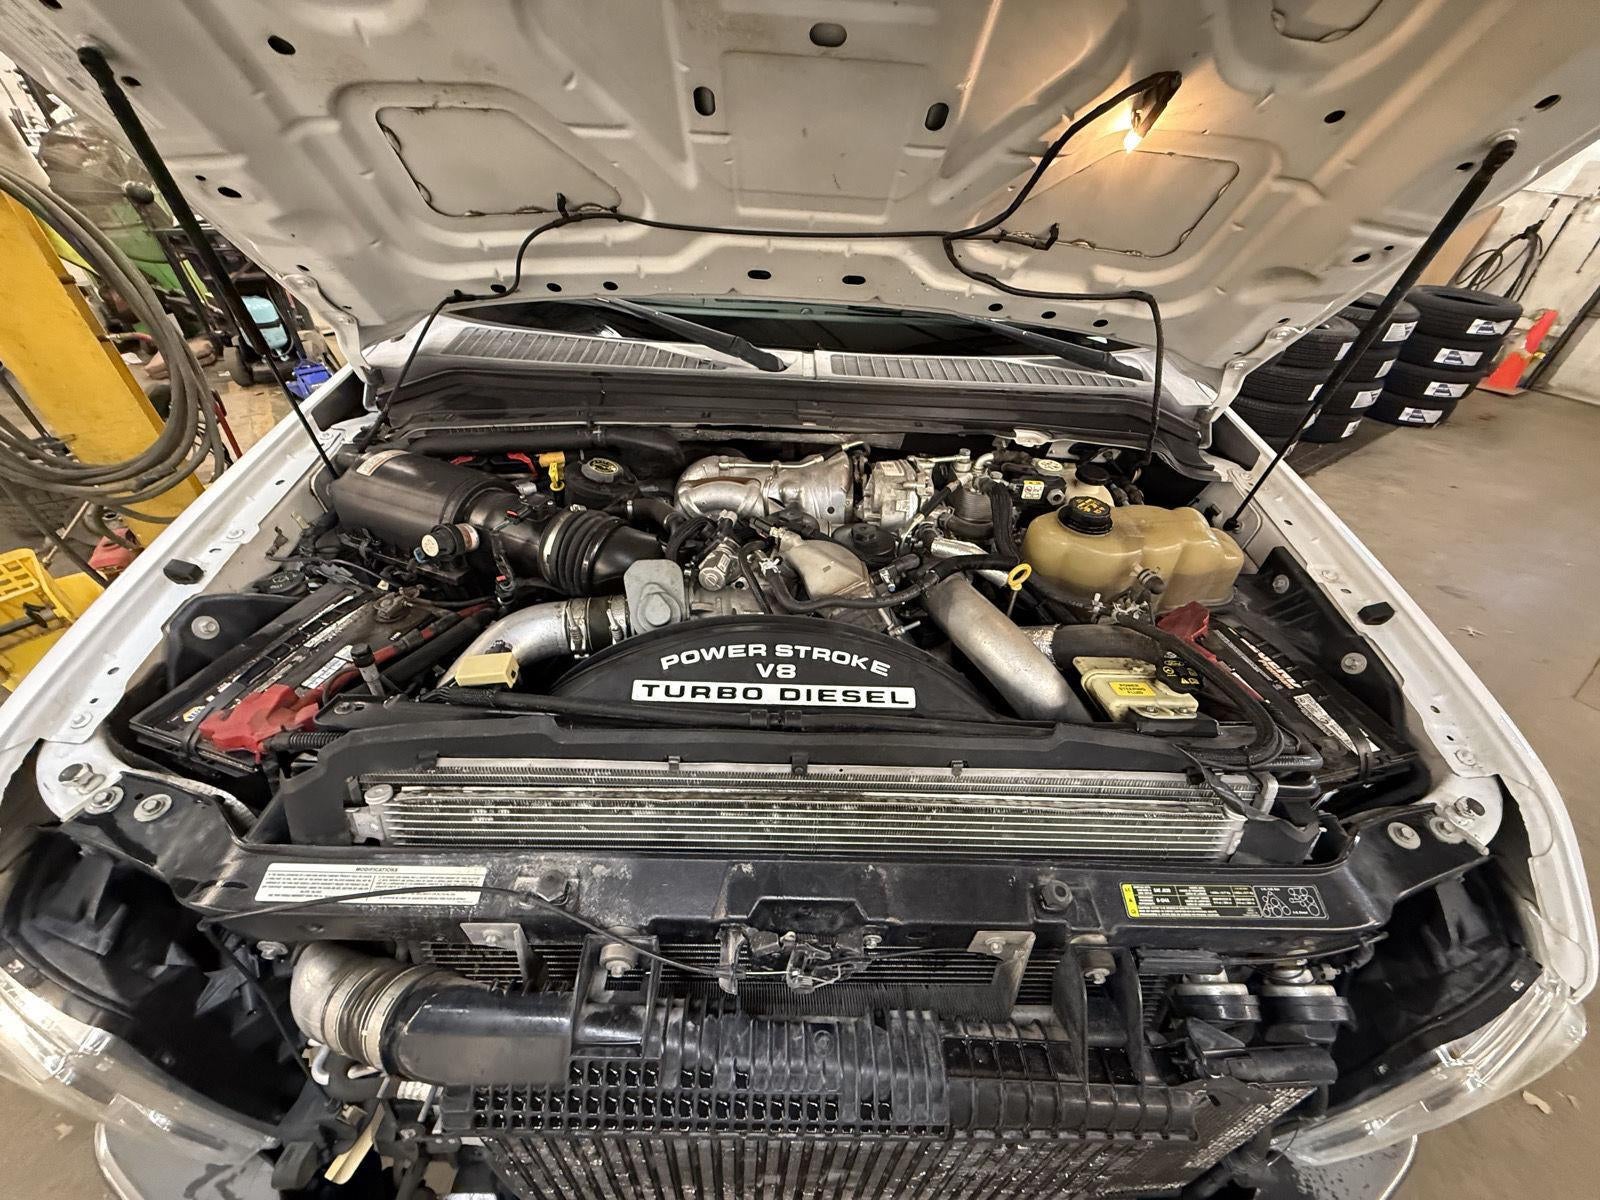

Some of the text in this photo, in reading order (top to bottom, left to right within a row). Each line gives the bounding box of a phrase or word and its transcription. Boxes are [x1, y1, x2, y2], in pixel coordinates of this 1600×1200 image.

[660, 643, 891, 677] POWER STROKE
[756, 663, 797, 679] V8
[642, 684, 910, 704] TURBO DIESEL
